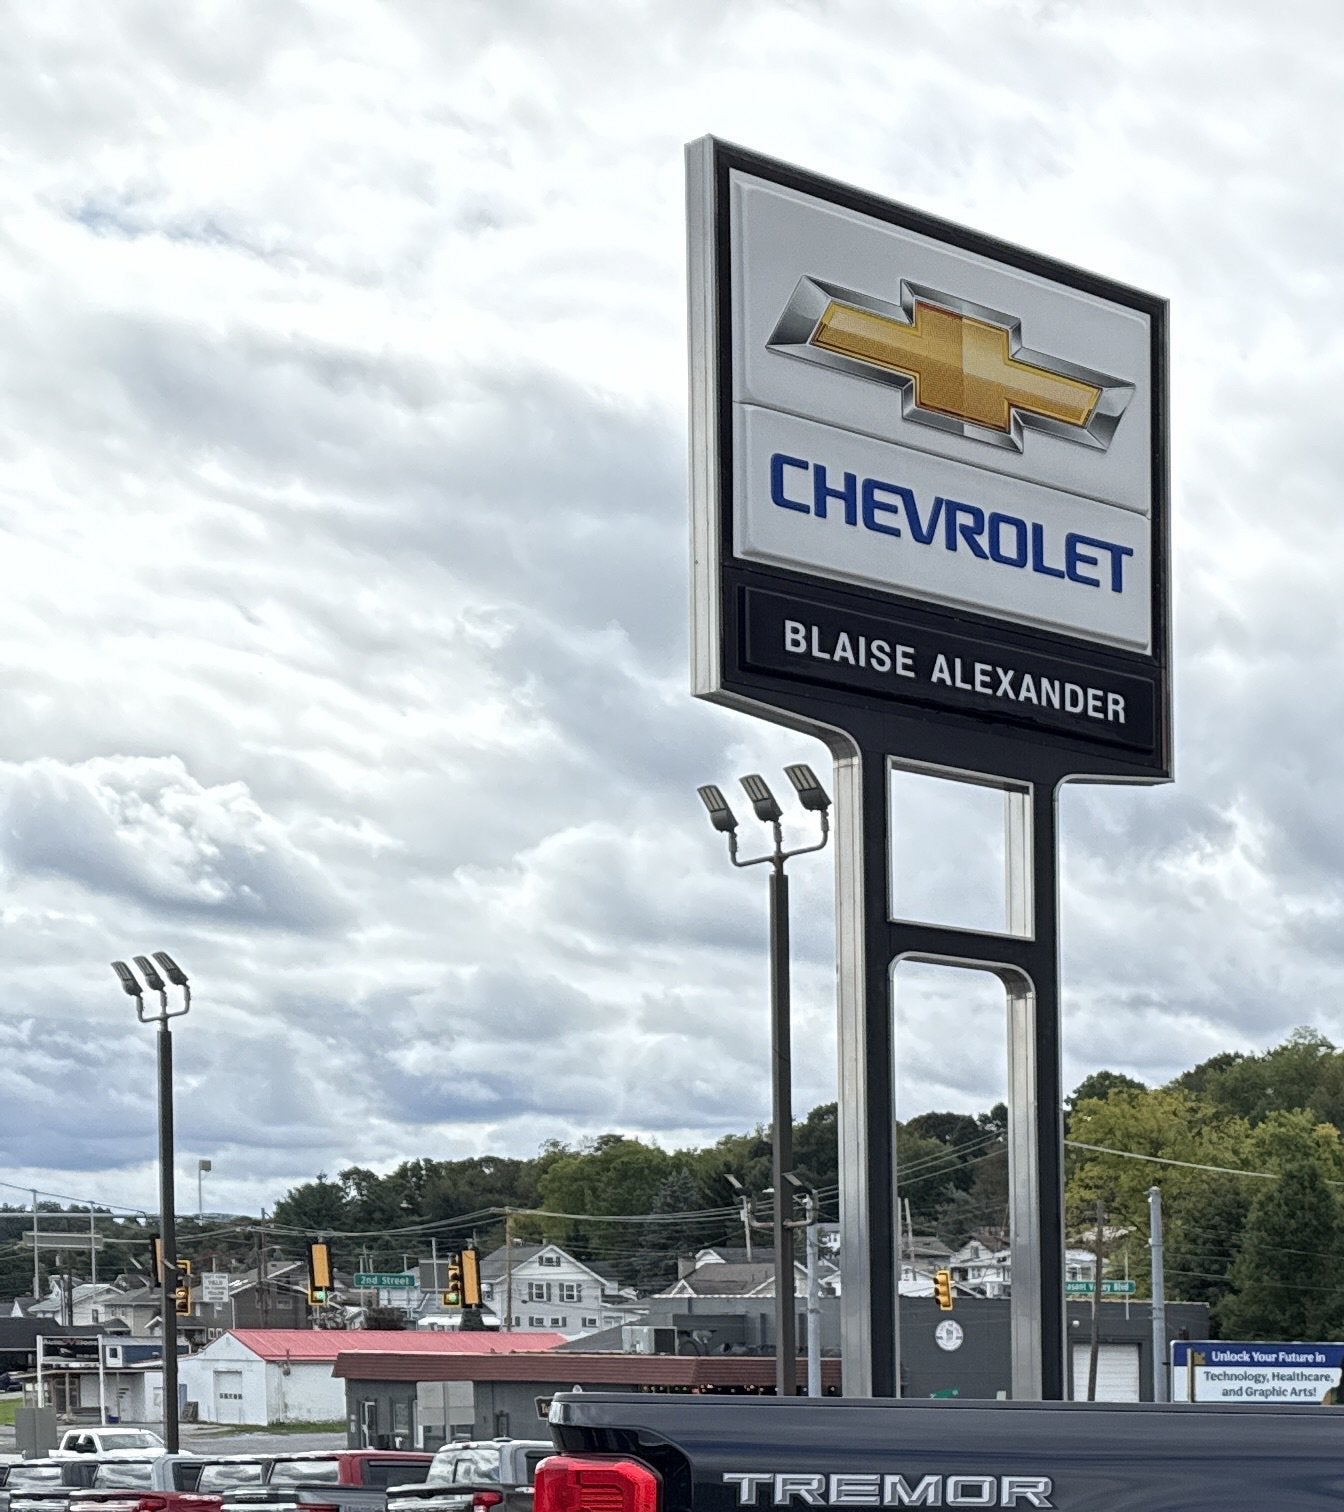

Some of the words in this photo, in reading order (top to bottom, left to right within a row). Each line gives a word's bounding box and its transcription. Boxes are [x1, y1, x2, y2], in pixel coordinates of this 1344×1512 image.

[770, 453, 1134, 593] CHEVROLET
[784, 619, 916, 678] BLAISE
[930, 653, 1127, 724] ALEXANDER
[360, 1275, 378, 1285] 2nd
[381, 1276, 410, 1285] Street
[1211, 1350, 1250, 1363] Unlock
[1250, 1351, 1278, 1363] Your
[1278, 1351, 1315, 1363] Future
[1315, 1351, 1326, 1363] in
[1203, 1370, 1270, 1384] Technology,
[1271, 1371, 1334, 1383] Healthcare,
[1221, 1386, 1244, 1397] and
[1245, 1386, 1289, 1399] Graphic
[1290, 1386, 1317, 1397] Arts!
[722, 1472, 1054, 1508] TREMOR
